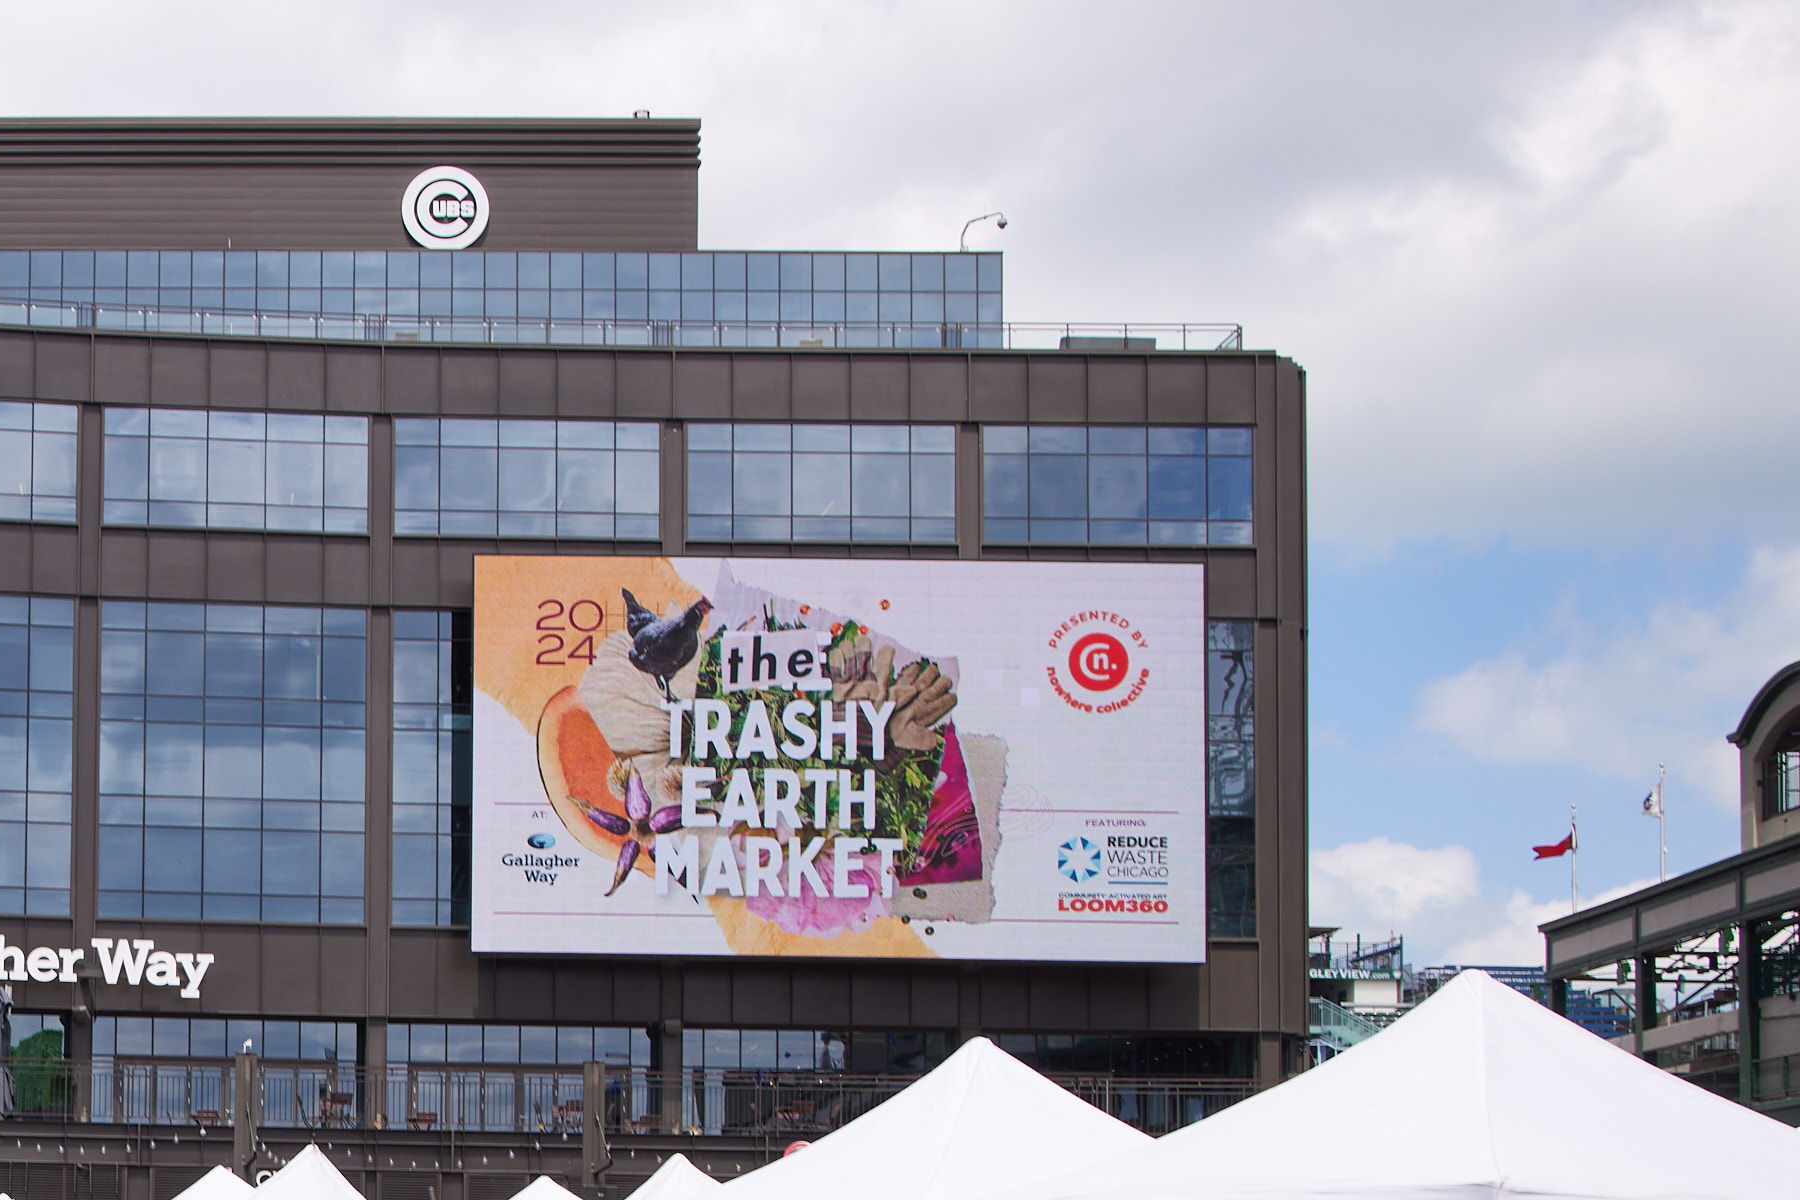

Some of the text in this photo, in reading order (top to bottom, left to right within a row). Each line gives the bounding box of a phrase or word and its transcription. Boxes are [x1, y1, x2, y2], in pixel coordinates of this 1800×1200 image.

[536, 599, 603, 632] 20
[1048, 610, 1148, 649] PRESENTED BY
[536, 634, 597, 665] 24
[728, 636, 815, 684] the
[1046, 666, 1150, 714] nowhere collective
[660, 698, 896, 760] TRASHY
[681, 767, 876, 830] EARTH
[1107, 836, 1168, 848] REDUCE
[1107, 850, 1168, 865] WASTE
[502, 853, 580, 870] Gallagher
[524, 869, 558, 885] Way
[655, 834, 903, 899] MARKET
[1107, 866, 1169, 878] CHICAGO
[1058, 899, 1168, 913] LOOM360
[92, 937, 214, 998] Way
